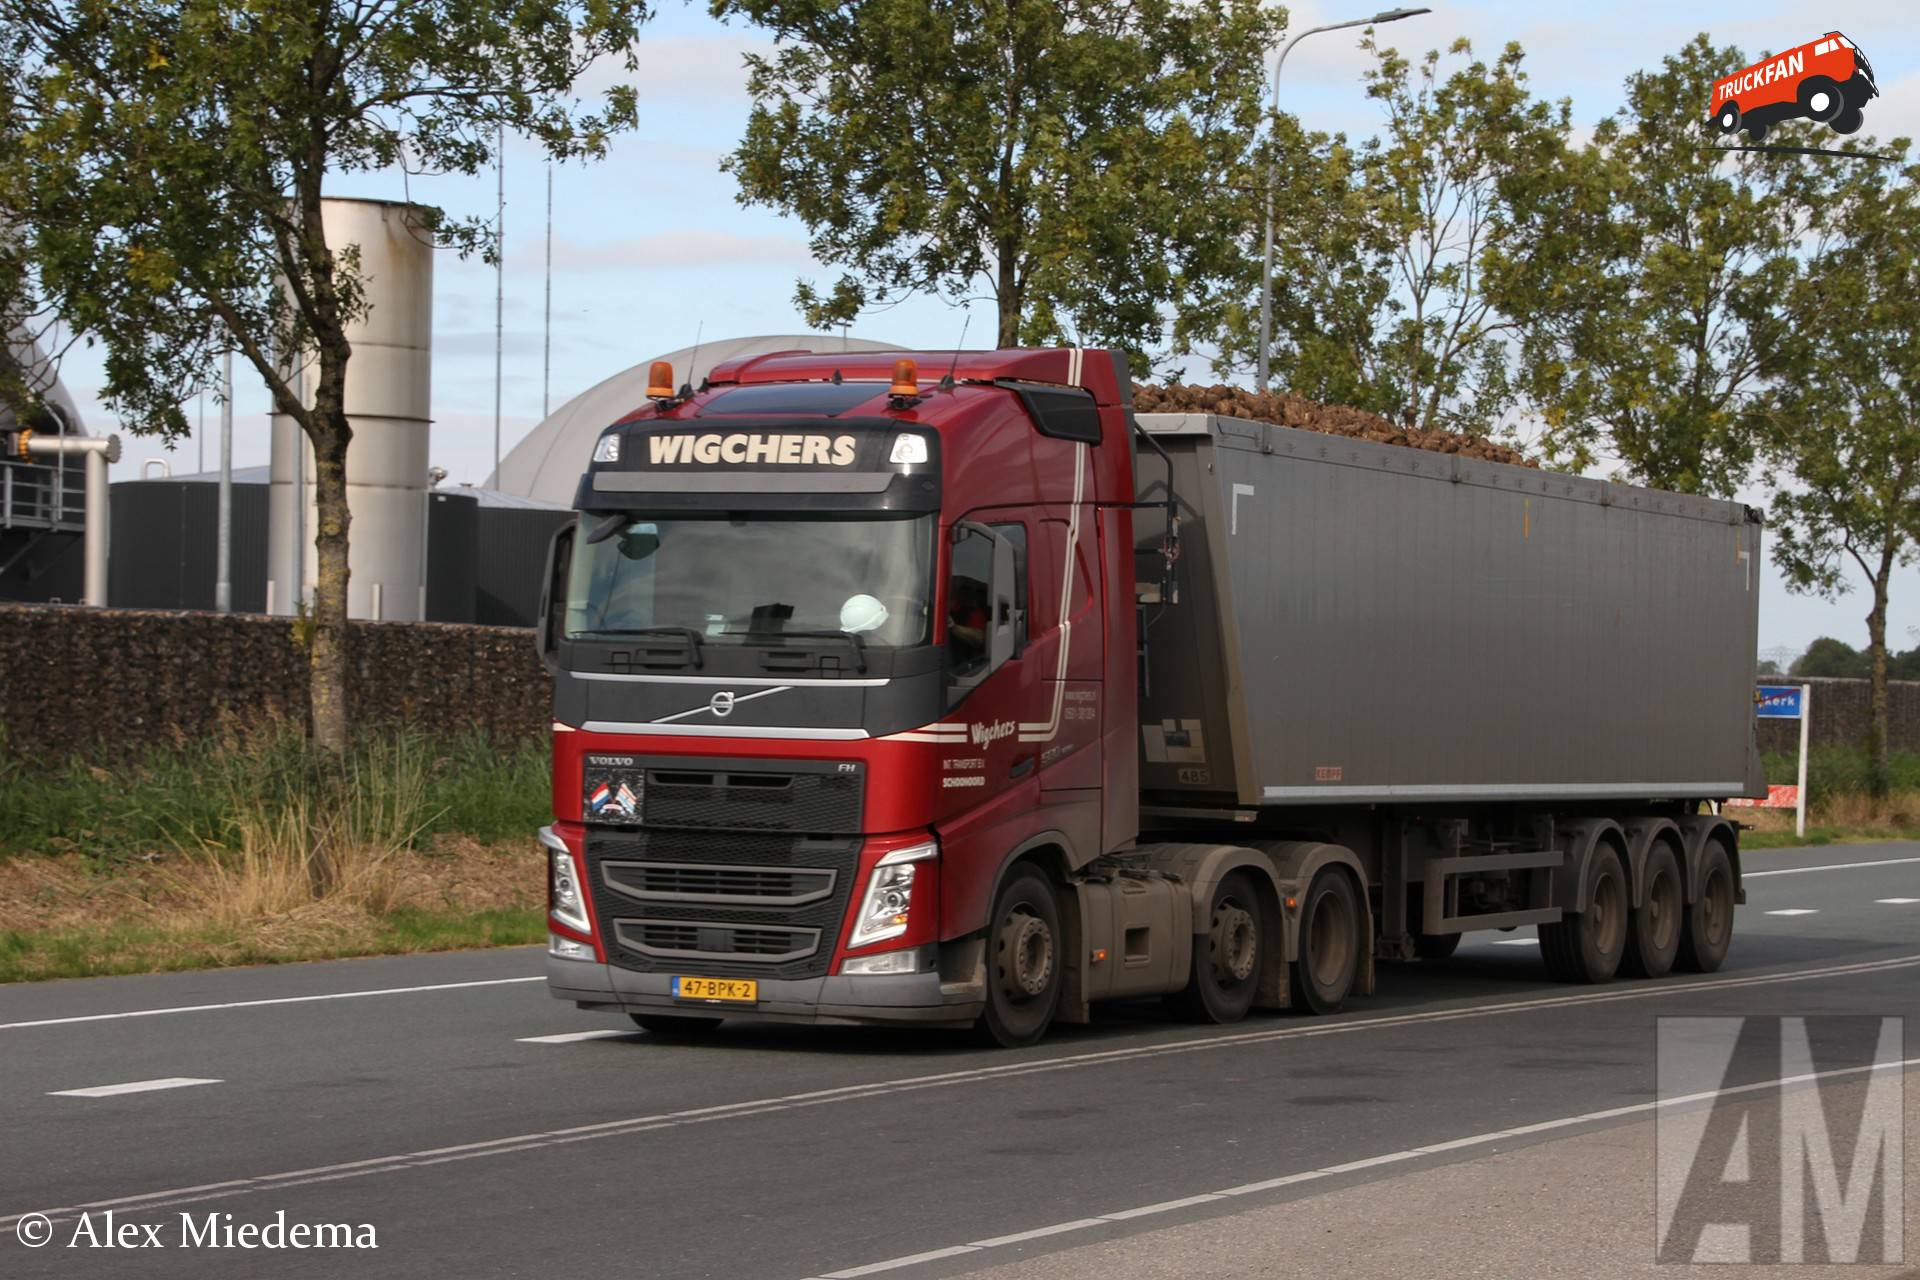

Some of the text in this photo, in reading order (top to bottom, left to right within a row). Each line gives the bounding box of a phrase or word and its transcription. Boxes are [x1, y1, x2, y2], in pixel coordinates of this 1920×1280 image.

[650, 434, 857, 465] WIGCHERS
[588, 756, 633, 766] VOLVO
[838, 764, 856, 772] FH
[684, 981, 751, 998] 47-BPK-2
